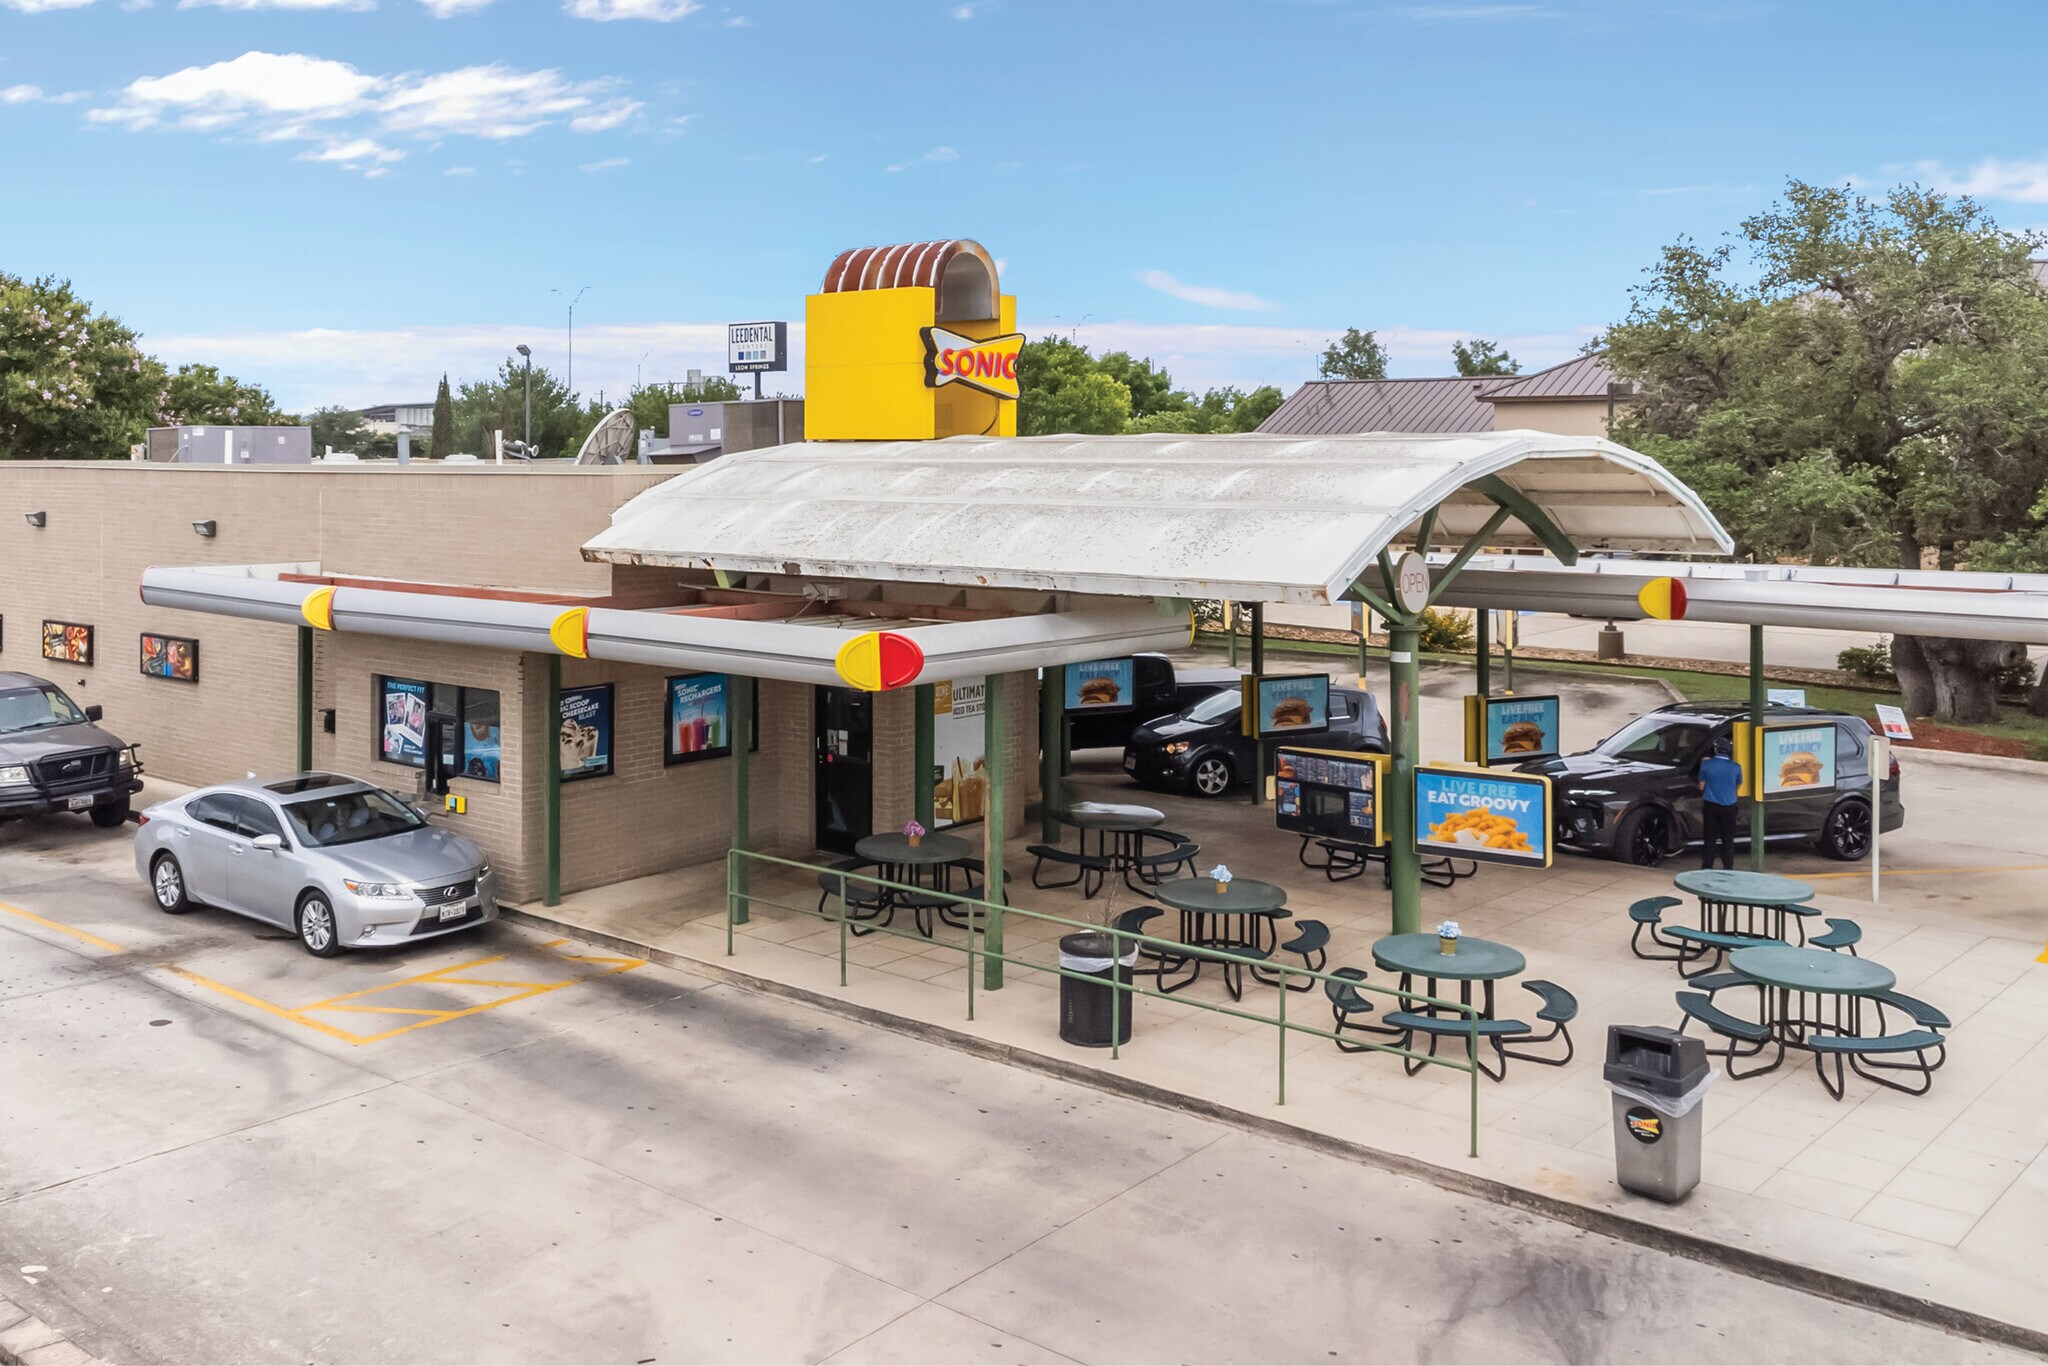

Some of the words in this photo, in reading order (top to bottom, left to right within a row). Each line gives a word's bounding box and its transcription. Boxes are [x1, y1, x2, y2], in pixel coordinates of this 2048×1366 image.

[940, 347, 1017, 380] SONIC
[1402, 572, 1429, 594] OPEN
[677, 684, 699, 697] SONIC
[680, 684, 722, 703] RECHARGERS
[953, 685, 985, 701] ULTIMAT
[562, 702, 599, 719] CHEESECAKE
[569, 698, 590, 710] SCOOP
[965, 704, 976, 714] TEA
[976, 702, 986, 712] STO
[1501, 705, 1522, 716] LIVE
[1523, 703, 1544, 714] FREE
[579, 709, 597, 720] BLAST
[1441, 779, 1477, 795] LIVE
[1479, 783, 1517, 799] FREE
[1428, 790, 1457, 805] EAT
[1459, 793, 1530, 813] GROOVY
